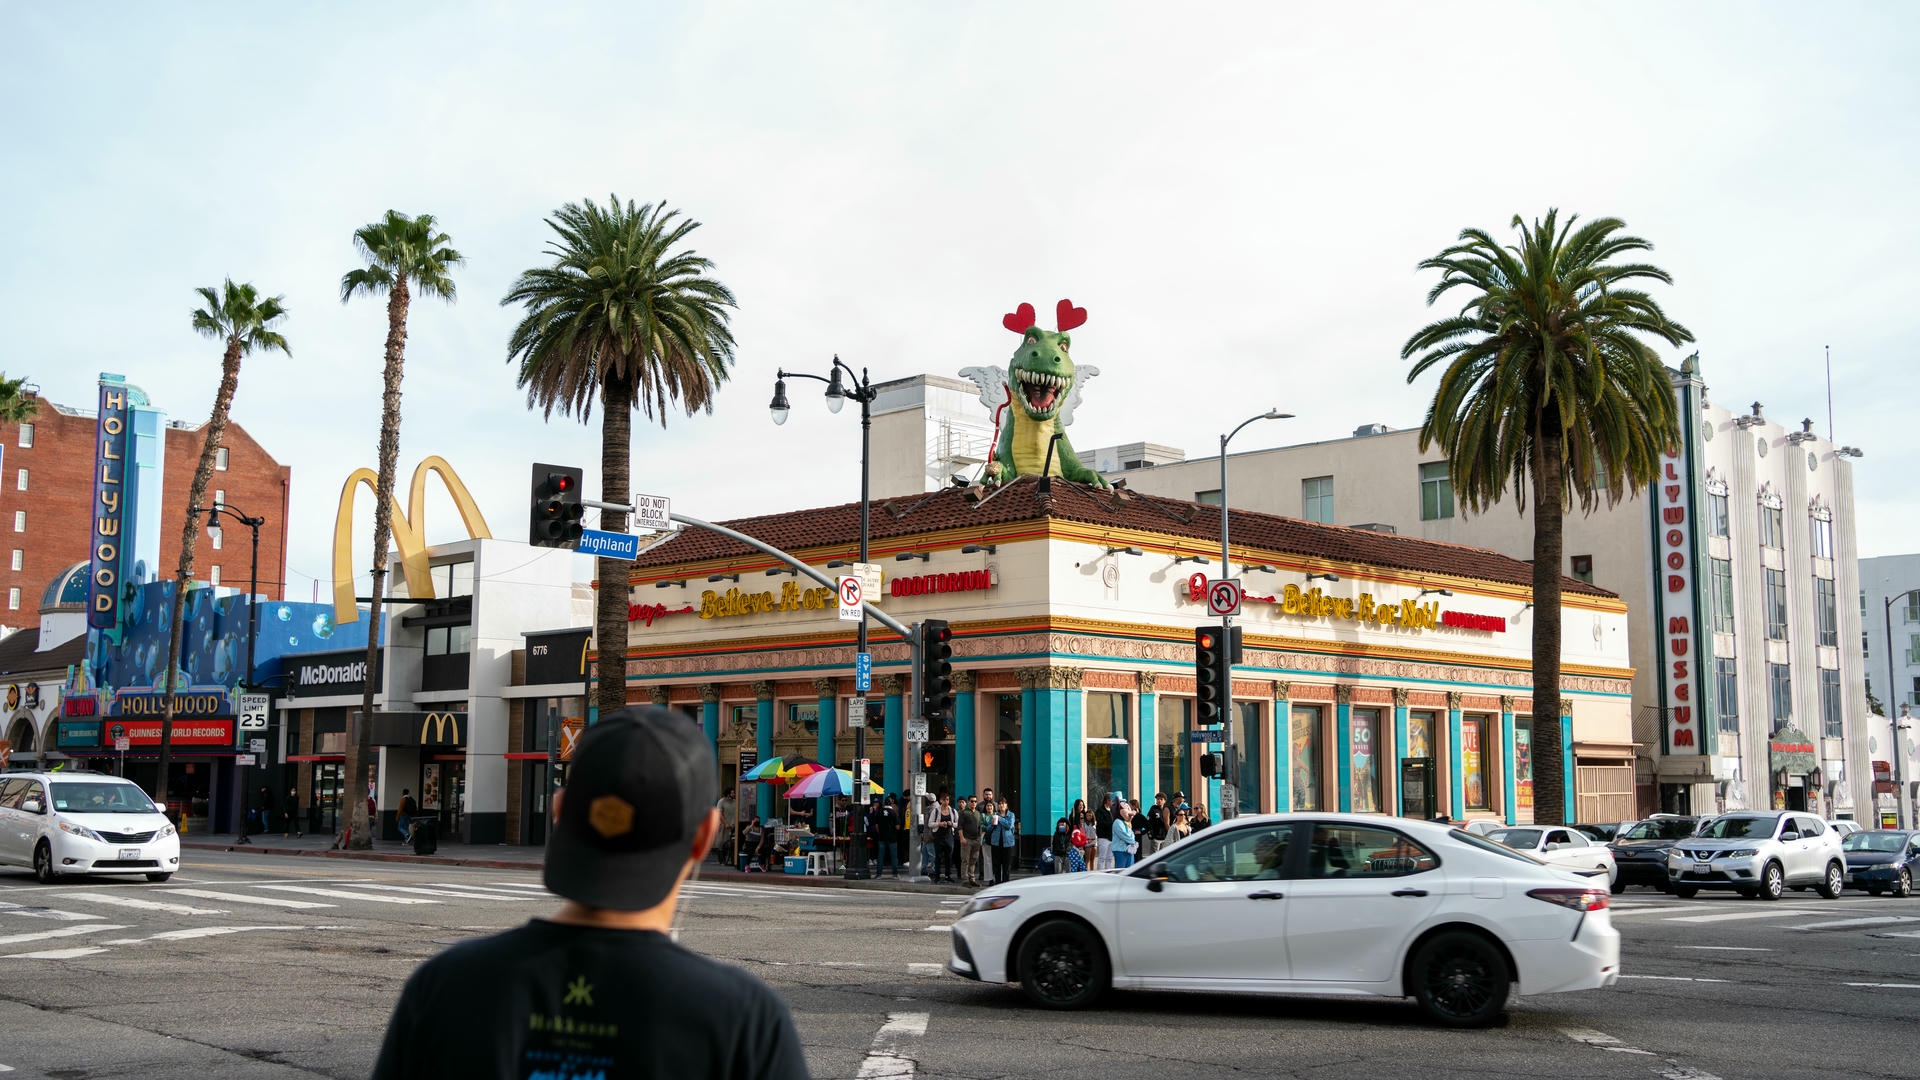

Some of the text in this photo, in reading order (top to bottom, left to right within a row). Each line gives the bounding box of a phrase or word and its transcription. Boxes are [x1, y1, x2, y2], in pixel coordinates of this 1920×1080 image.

[96, 391, 123, 612] HOLLYWOOD
[640, 497, 666, 509] DO NOT
[641, 509, 664, 520] BLOCK
[636, 518, 668, 528] INTERSECTION
[580, 534, 632, 553] Highland
[891, 570, 991, 598] ODDITORIUM
[698, 587, 775, 619] Believe
[779, 581, 801, 611] It
[803, 587, 830, 610] or
[1282, 584, 1353, 619] Believe
[1358, 593, 1376, 622] It
[1376, 603, 1398, 625] or
[1401, 599, 1439, 630] Not!
[841, 608, 861, 617] ON RED
[532, 645, 548, 656] 6776
[862, 655, 870, 688] SYNC
[1669, 617, 1695, 747] MUSEUM
[241, 714, 265, 727] 25
[193, 728, 225, 737] RECORDS
[907, 731, 917, 740] OK
[1354, 728, 1371, 743] 50
